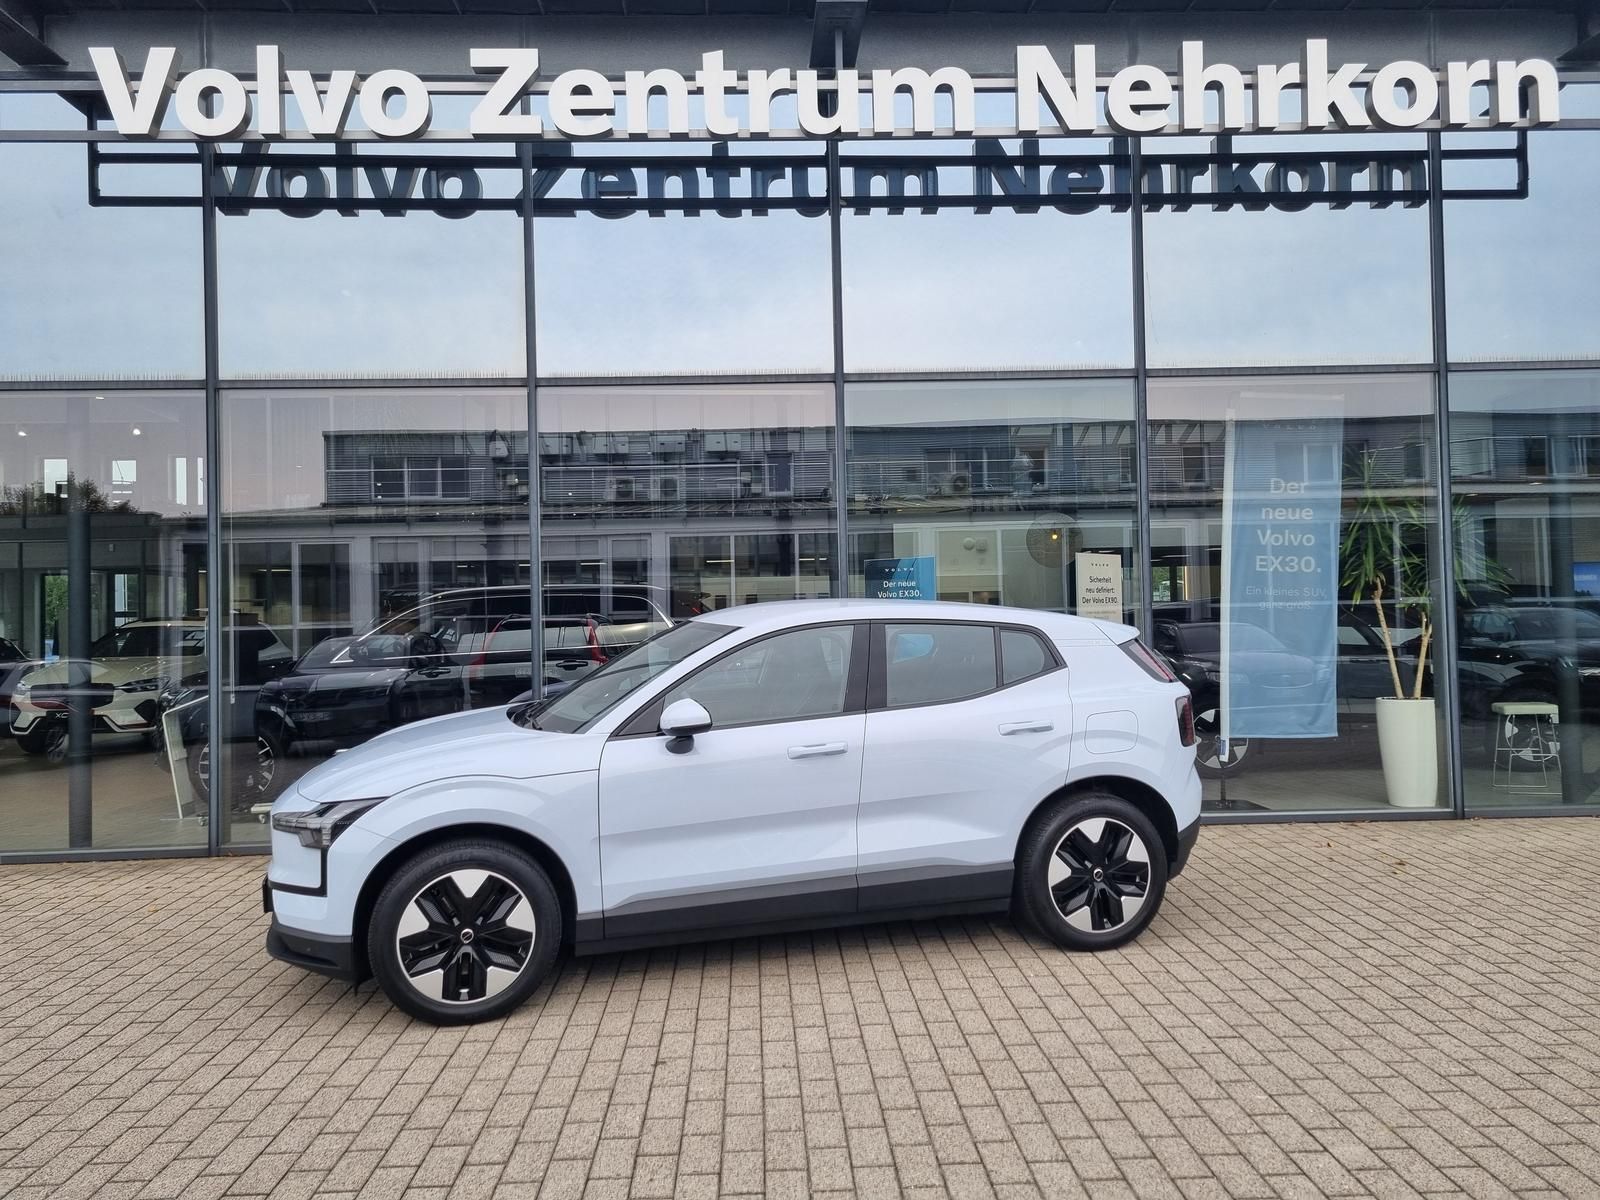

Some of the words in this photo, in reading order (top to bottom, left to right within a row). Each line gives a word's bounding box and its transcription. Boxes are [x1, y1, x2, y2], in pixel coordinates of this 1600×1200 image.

[88, 44, 433, 139] Volvo
[470, 47, 976, 138] Zentrum
[1016, 38, 1560, 133] Nehrkorn
[1270, 477, 1309, 494] Der
[1261, 505, 1314, 520] neue
[1257, 529, 1316, 547] Volvo
[1255, 555, 1322, 573] EX30.
[883, 580, 896, 588] Der
[898, 579, 916, 587] neue
[1089, 576, 1112, 584] Sicherheit
[877, 590, 898, 598] Volvo
[899, 589, 922, 598] EX30.
[1246, 586, 1261, 596] Ein
